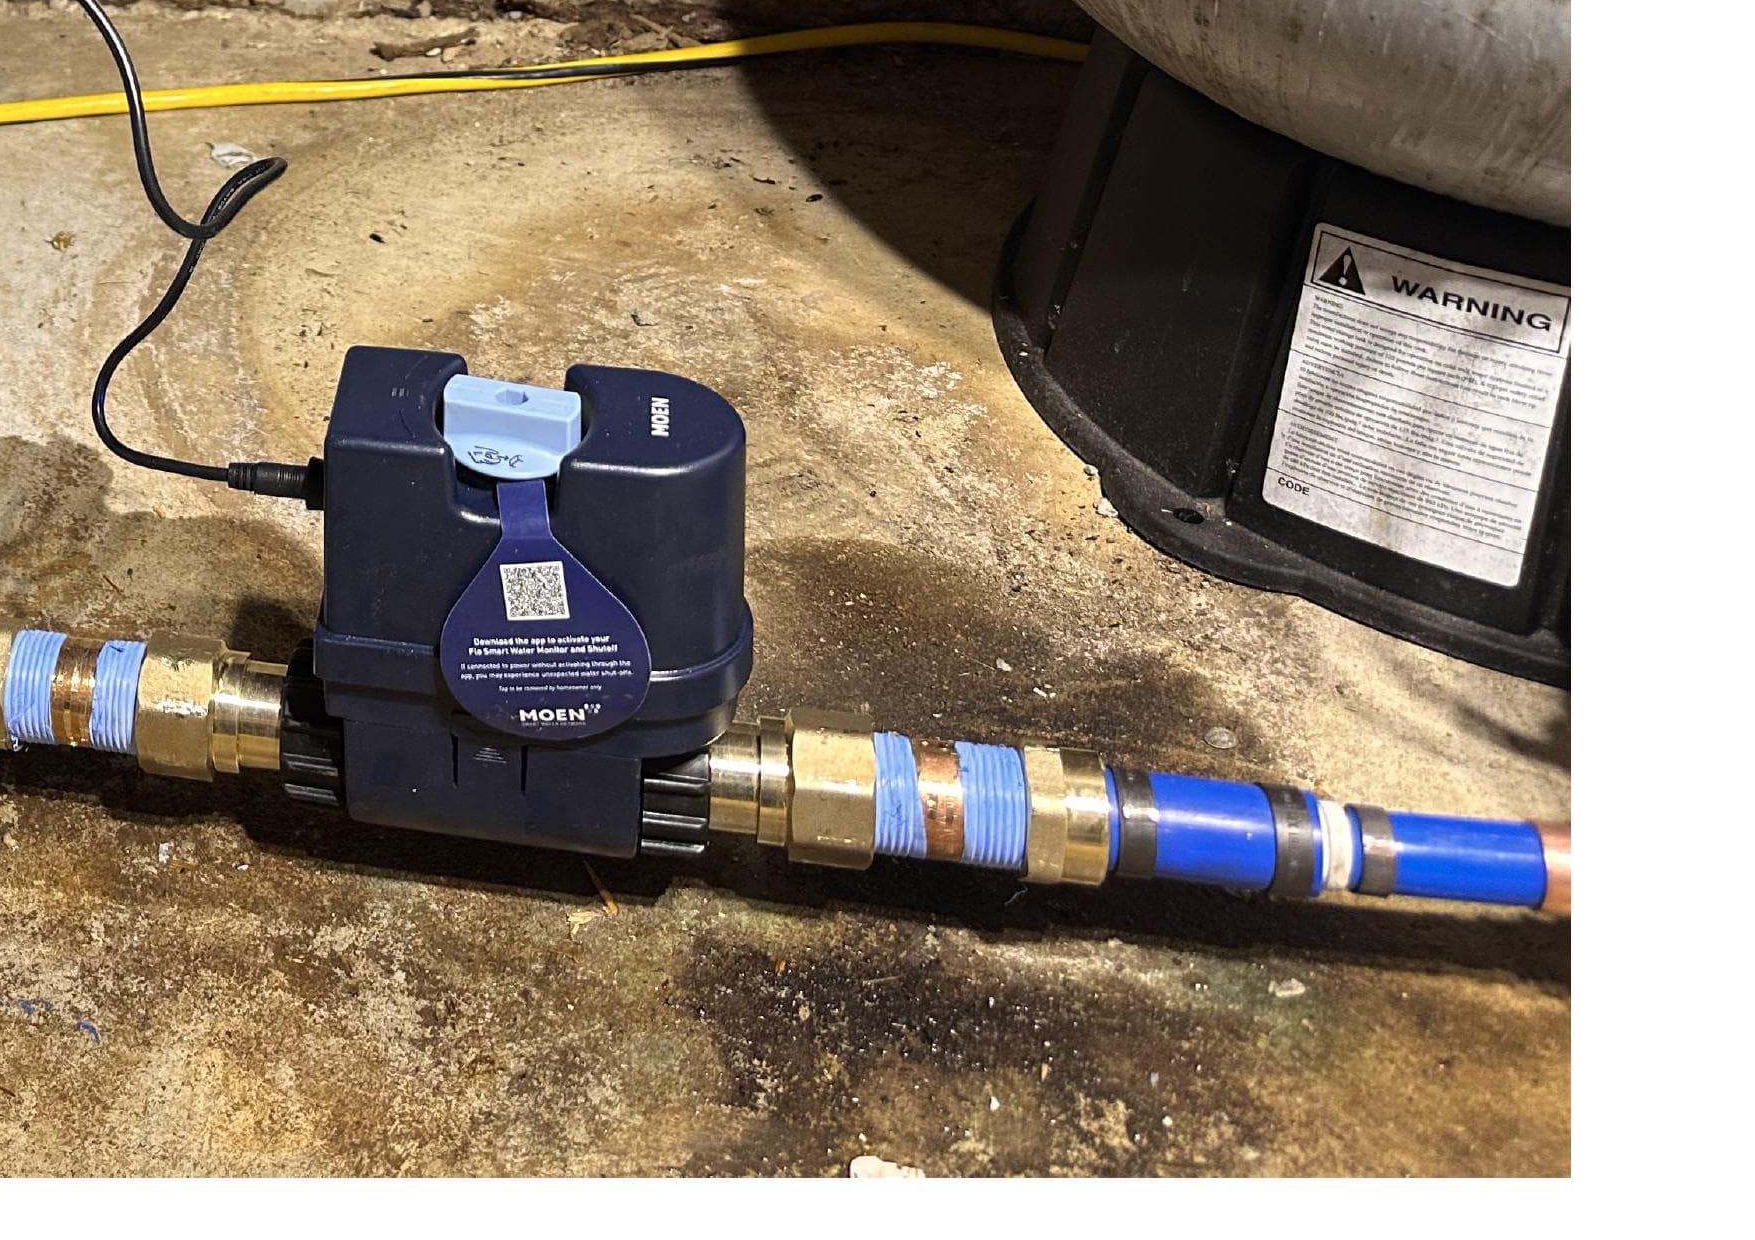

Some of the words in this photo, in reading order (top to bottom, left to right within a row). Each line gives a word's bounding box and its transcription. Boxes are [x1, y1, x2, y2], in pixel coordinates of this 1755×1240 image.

[1391, 275, 1553, 331] WARNING
[651, 396, 670, 437] MOEN
[1277, 475, 1311, 496] CODE
[474, 637, 514, 646] Download
[515, 637, 528, 645] the
[531, 638, 545, 647] app
[557, 635, 589, 644] activate
[591, 635, 610, 645] your
[469, 647, 483, 656] Flo
[484, 647, 509, 655] Smart
[510, 646, 534, 654] Water
[537, 645, 568, 654] Monitor
[570, 645, 585, 653] and
[587, 644, 618, 653] Shutoff
[558, 661, 590, 669] activating
[592, 660, 618, 668] through
[519, 709, 586, 722] MOEN
